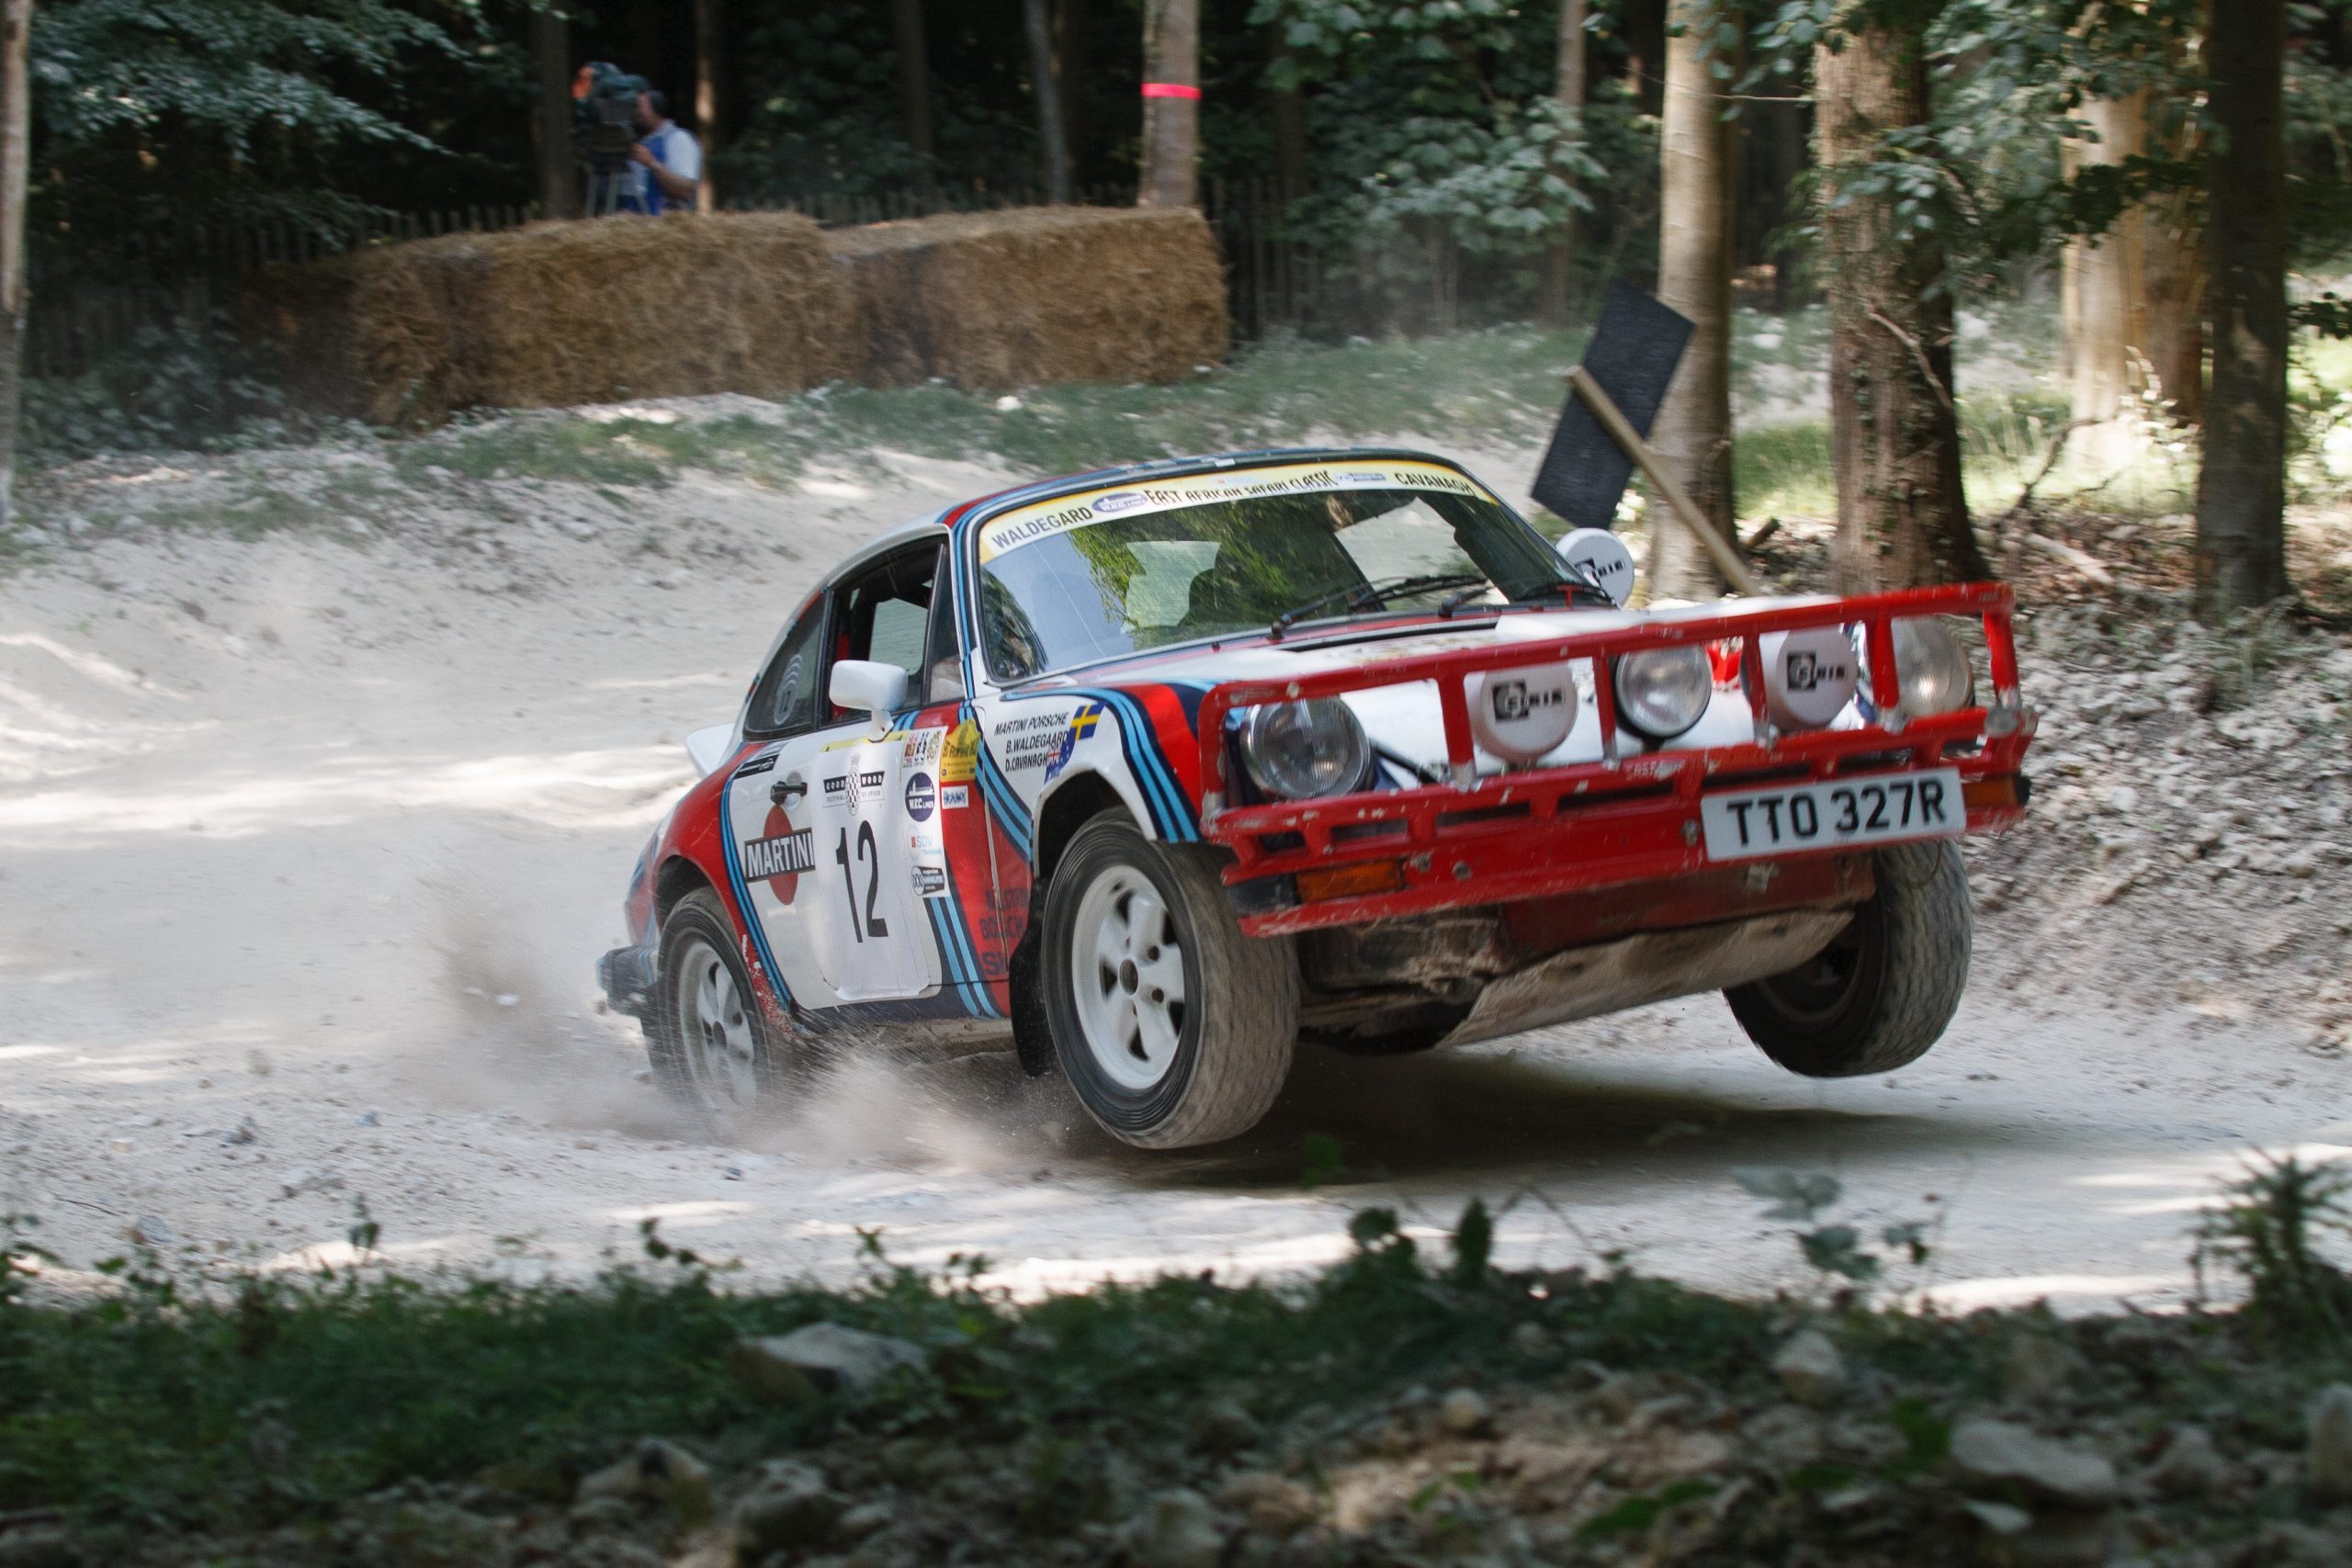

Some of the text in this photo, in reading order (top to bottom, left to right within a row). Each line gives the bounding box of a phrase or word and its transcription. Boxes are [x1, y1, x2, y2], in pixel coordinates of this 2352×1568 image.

[1144, 489, 1183, 506] EAST
[1185, 488, 1243, 502] AFRICAN
[1244, 479, 1289, 494] SAFARI
[1290, 469, 1339, 489] CLASSIC
[1395, 472, 1475, 497] CAVANAGH
[991, 507, 1093, 548] WALDEGARD
[994, 712, 1069, 735] MARTINI PORSCHE
[1005, 752, 1049, 773] D.CAVANAGH
[1725, 777, 1946, 847] TTO 327R
[747, 831, 816, 878] MARTINI
[835, 820, 888, 943] 12
